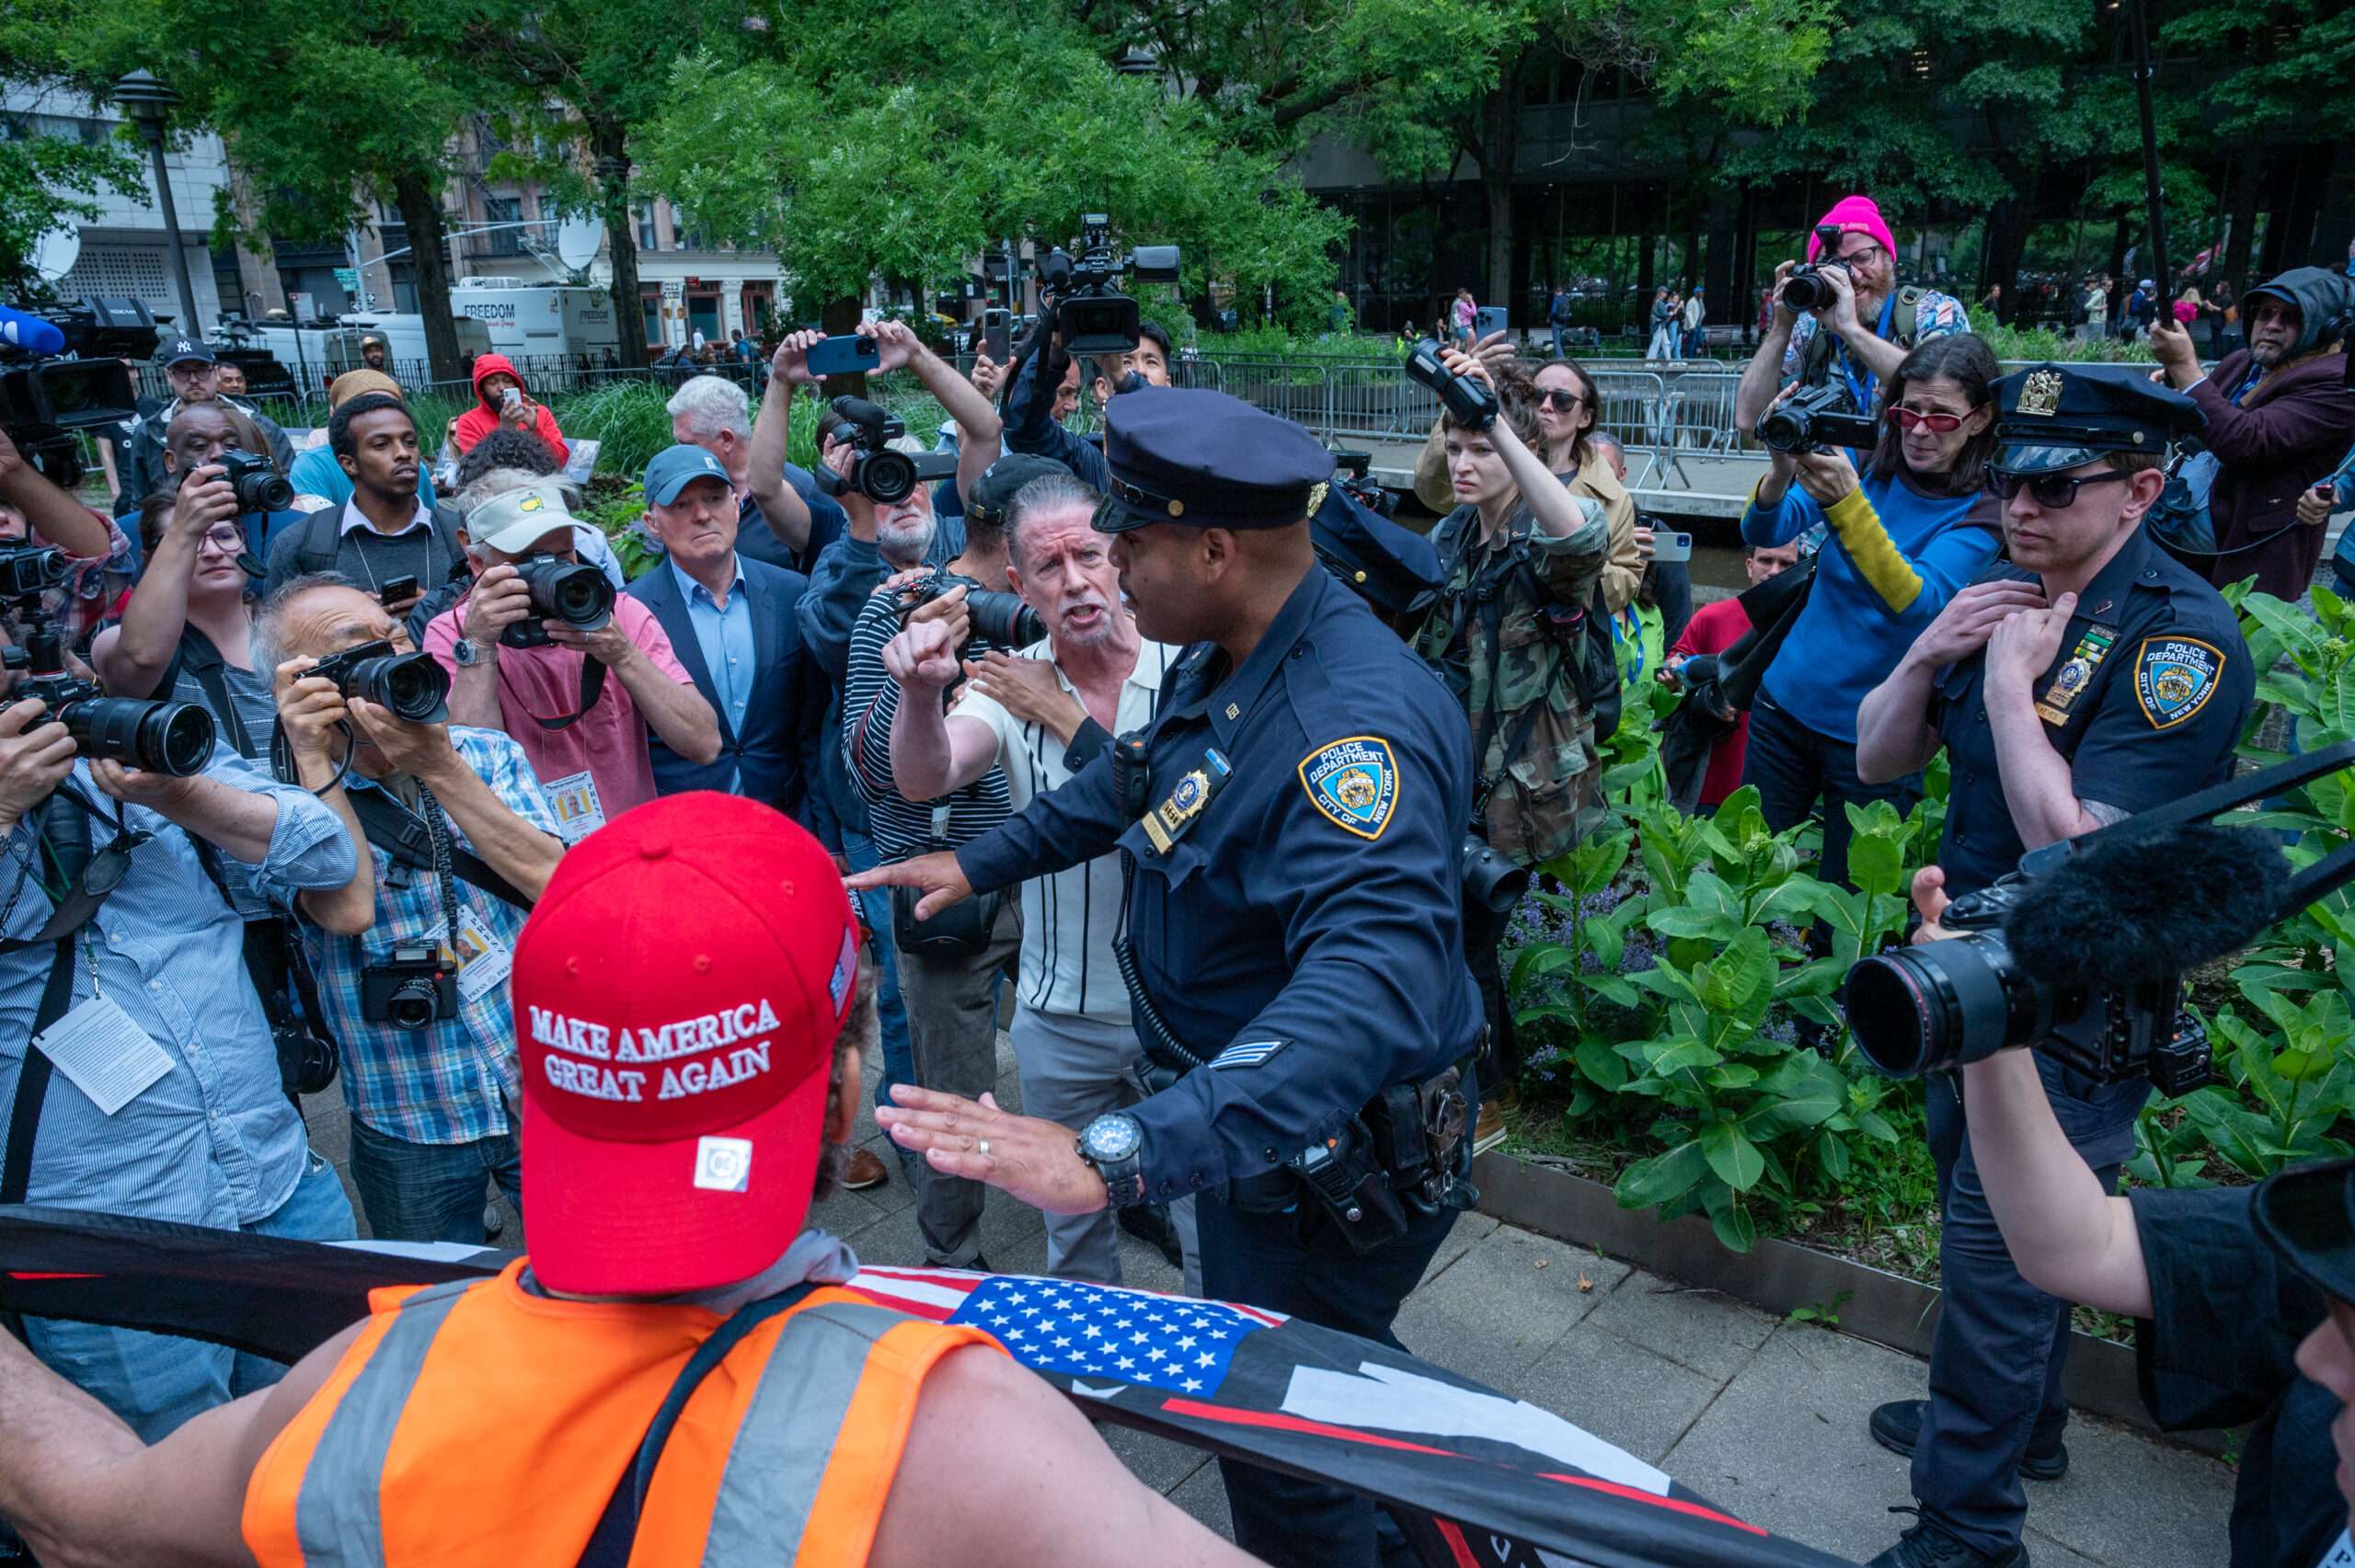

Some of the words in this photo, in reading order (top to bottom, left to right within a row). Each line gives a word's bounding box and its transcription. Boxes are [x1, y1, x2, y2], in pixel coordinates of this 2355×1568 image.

[464, 303, 515, 318] FREEDOM
[2146, 651, 2215, 676] DEPARTMENT
[2165, 643, 2207, 660] POLICE
[2140, 672, 2151, 694] CITY
[2190, 681, 2213, 705] YORK
[2144, 696, 2156, 711] OF
[2169, 703, 2192, 720] NEW
[1320, 741, 1364, 763] POLICE
[1309, 750, 1384, 784] DEPARTMENT
[1317, 794, 1341, 816] CITY
[1340, 811, 1359, 824] OF
[1373, 800, 1389, 824] NEW
[1382, 769, 1393, 797] YORK
[470, 918, 506, 956] PRESS
[529, 1005, 612, 1060] MAKE
[615, 998, 781, 1064] AMERICA
[545, 1054, 647, 1103] GREAT
[657, 1040, 771, 1101] AGAIN
